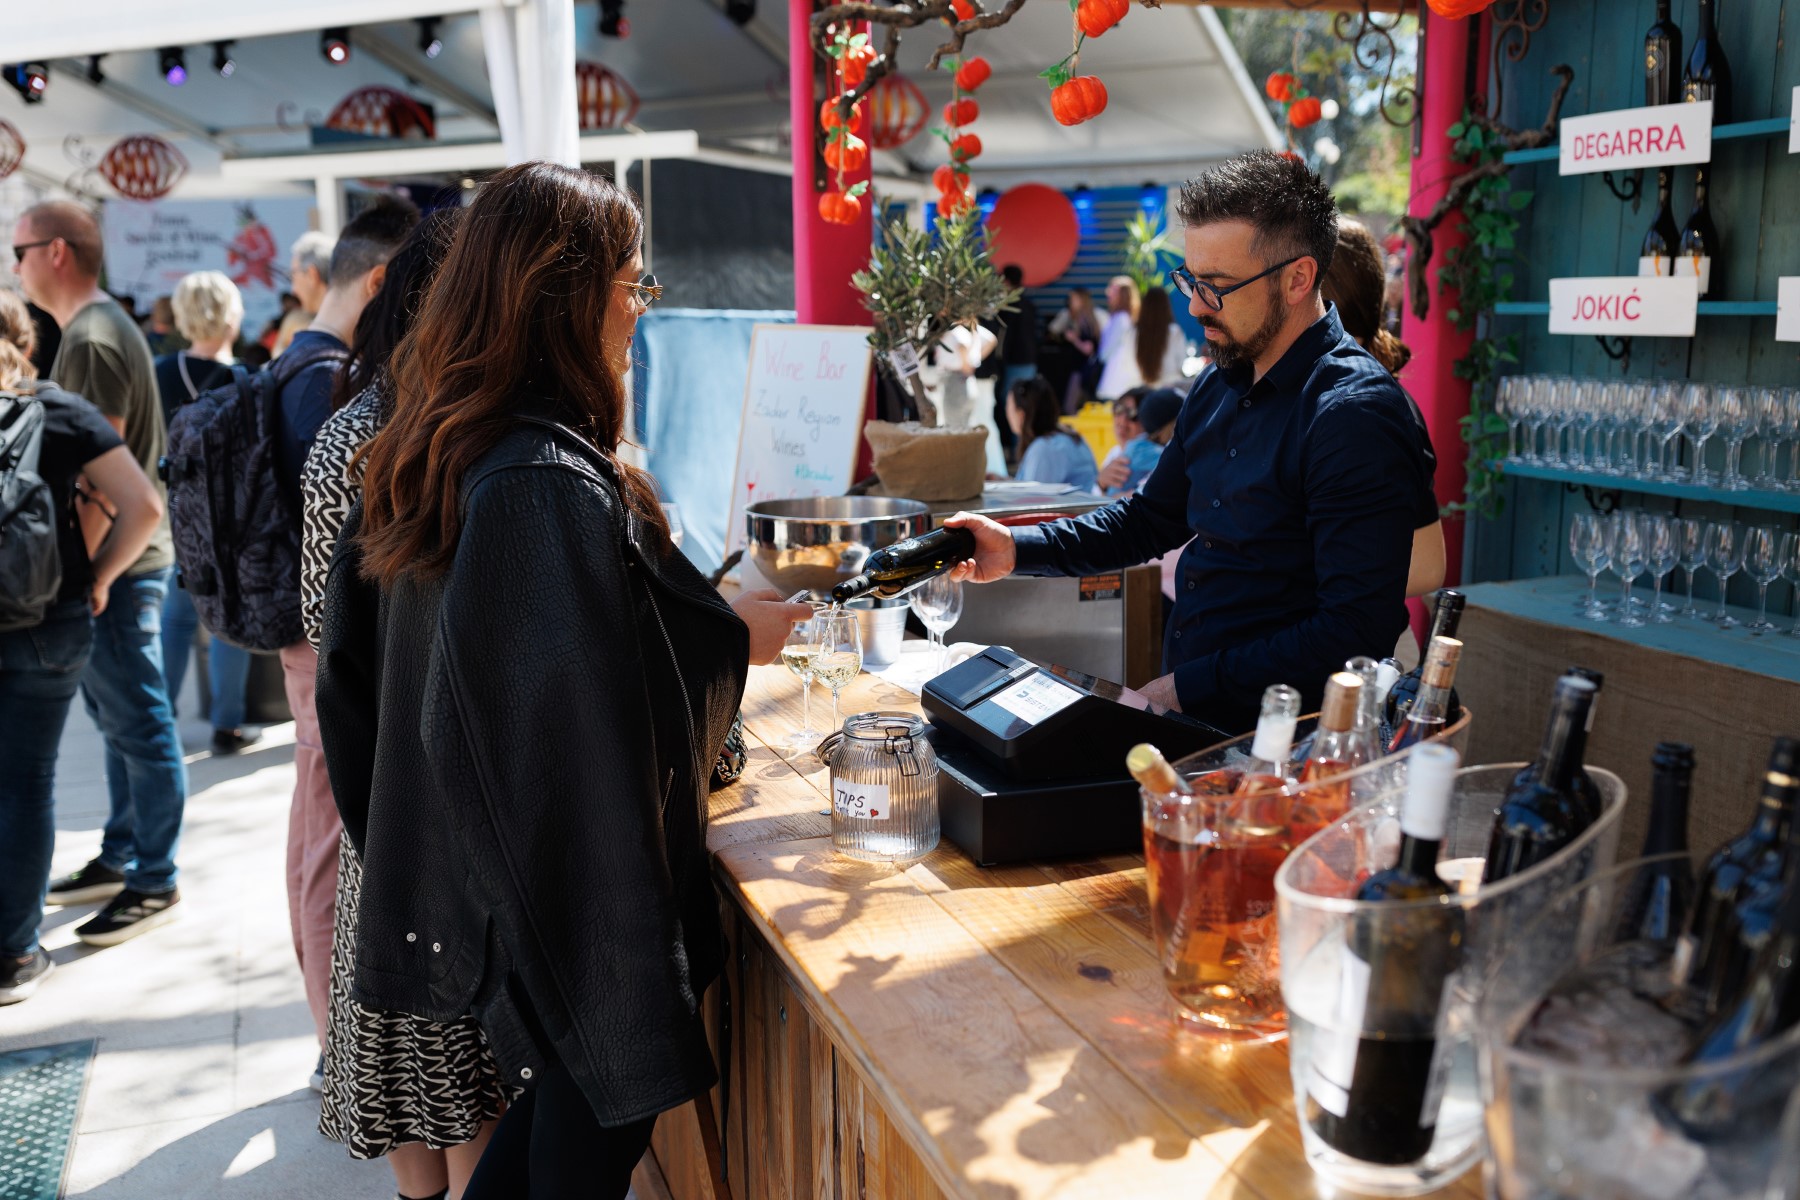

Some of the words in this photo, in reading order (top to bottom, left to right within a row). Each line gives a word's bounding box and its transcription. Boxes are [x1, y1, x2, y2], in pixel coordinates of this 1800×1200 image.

[1573, 123, 1686, 161] DEGARRA
[1572, 287, 1642, 321] JOKIĆ
[764, 338, 805, 381] Wine
[816, 340, 848, 380] Bar
[771, 425, 806, 457] Wines
[837, 789, 865, 808] TIPS
